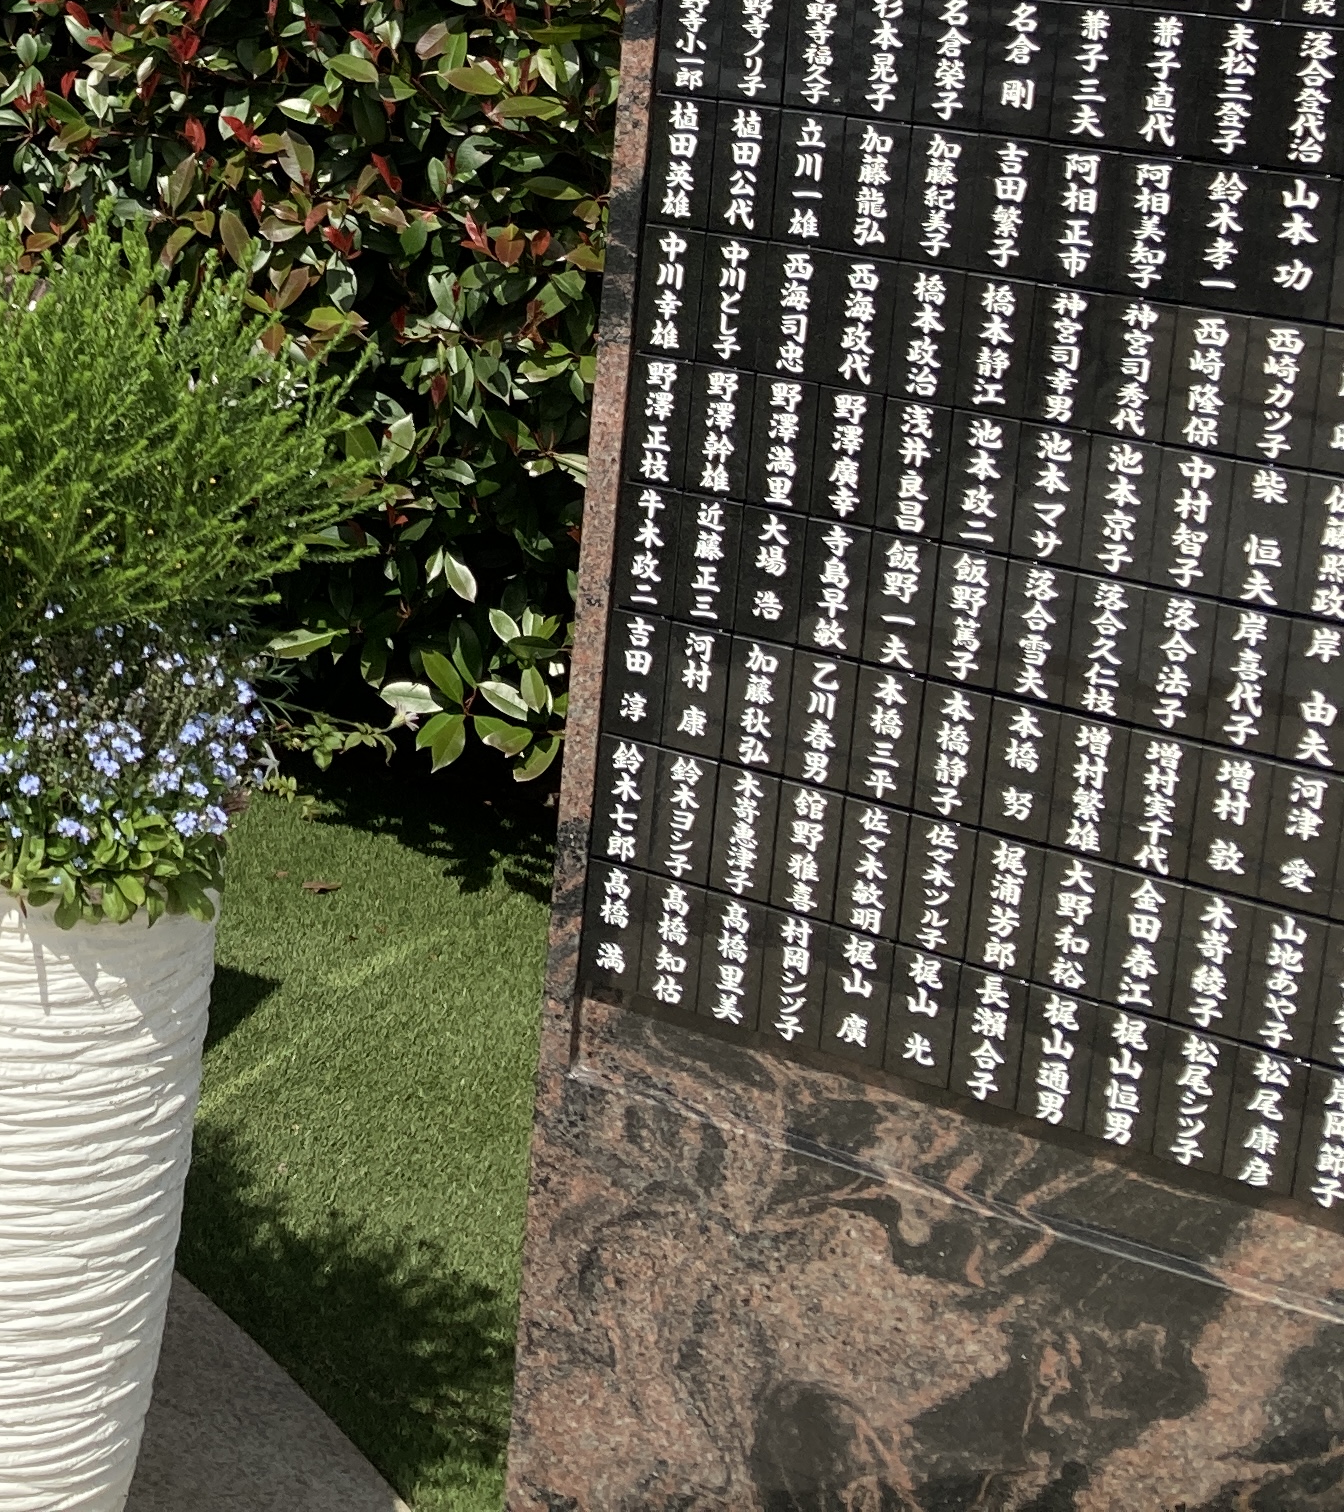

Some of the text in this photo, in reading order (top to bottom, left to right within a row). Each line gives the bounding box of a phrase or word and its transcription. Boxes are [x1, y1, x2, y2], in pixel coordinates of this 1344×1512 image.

[1069, 9, 1111, 138] 兼子三夫
[1138, 16, 1184, 147] 兼子直代
[1287, 32, 1338, 163] 落合登代治
[661, 100, 699, 219] 植田英雄
[723, 109, 763, 230] 植田公代
[787, 117, 827, 238] 立川一雄
[853, 124, 894, 247] 加藤龍弘
[919, 133, 962, 257] 加藤紀美子
[986, 142, 1029, 268] 吉田繁子
[649, 230, 687, 349] 中川幸雄
[1199, 171, 1248, 289] 鈴木孝一
[712, 240, 750, 360] 中川とし子
[776, 253, 814, 373] 西海司忠
[837, 263, 879, 385] 西海政代
[905, 272, 947, 397] 橋本政治
[971, 282, 1016, 405] 橋本静江
[1044, 292, 1088, 423] 神宮司幸男
[639, 361, 678, 482] 野澤正枝
[699, 371, 739, 492] 野澤幹雄
[1109, 303, 1159, 437] 神宮司秀代
[764, 382, 803, 507] 野澤満里
[894, 405, 934, 533] 浅井良昌
[958, 418, 1003, 543] 池本政二
[1029, 431, 1073, 558] 池本マサ
[630, 488, 666, 605] 牛木政二
[689, 501, 726, 620] 近藤正三
[1095, 443, 1144, 573] 池本京子
[1167, 455, 1216, 588] 中村智子
[878, 539, 921, 669] 飯野一夫
[945, 552, 990, 681] 飯野篤子
[1014, 568, 1059, 699] 落合雪夫
[1080, 582, 1129, 717] 落合久仁枝
[1152, 597, 1200, 729] 落合法子
[738, 643, 779, 764] 加藤秋弘
[801, 662, 840, 784] 乙川春男
[863, 674, 908, 799] 本橋三平
[1222, 611, 1268, 746] 岸喜代子
[606, 741, 645, 862] 鈴木七郎
[930, 690, 975, 816] 本橋静子
[1064, 725, 1113, 852] 増村繁雄
[1133, 741, 1183, 874] 増村実千代
[664, 756, 704, 878] 鈴木ヨシ子
[849, 807, 892, 934] 佐々木敏明
[915, 824, 959, 950] 佐々木ツル子
[982, 840, 1028, 969] 梶浦芳郎
[1049, 859, 1096, 989] 大野和裕
[1117, 878, 1166, 1007] 金田春江
[774, 916, 813, 1041] 村岡シヅ子
[1258, 915, 1308, 1046] 山地あや子
[1035, 993, 1080, 1123] 梶山通男
[1103, 1012, 1149, 1143] 梶山恒男
[1237, 1053, 1292, 1186] 松尾康彦
